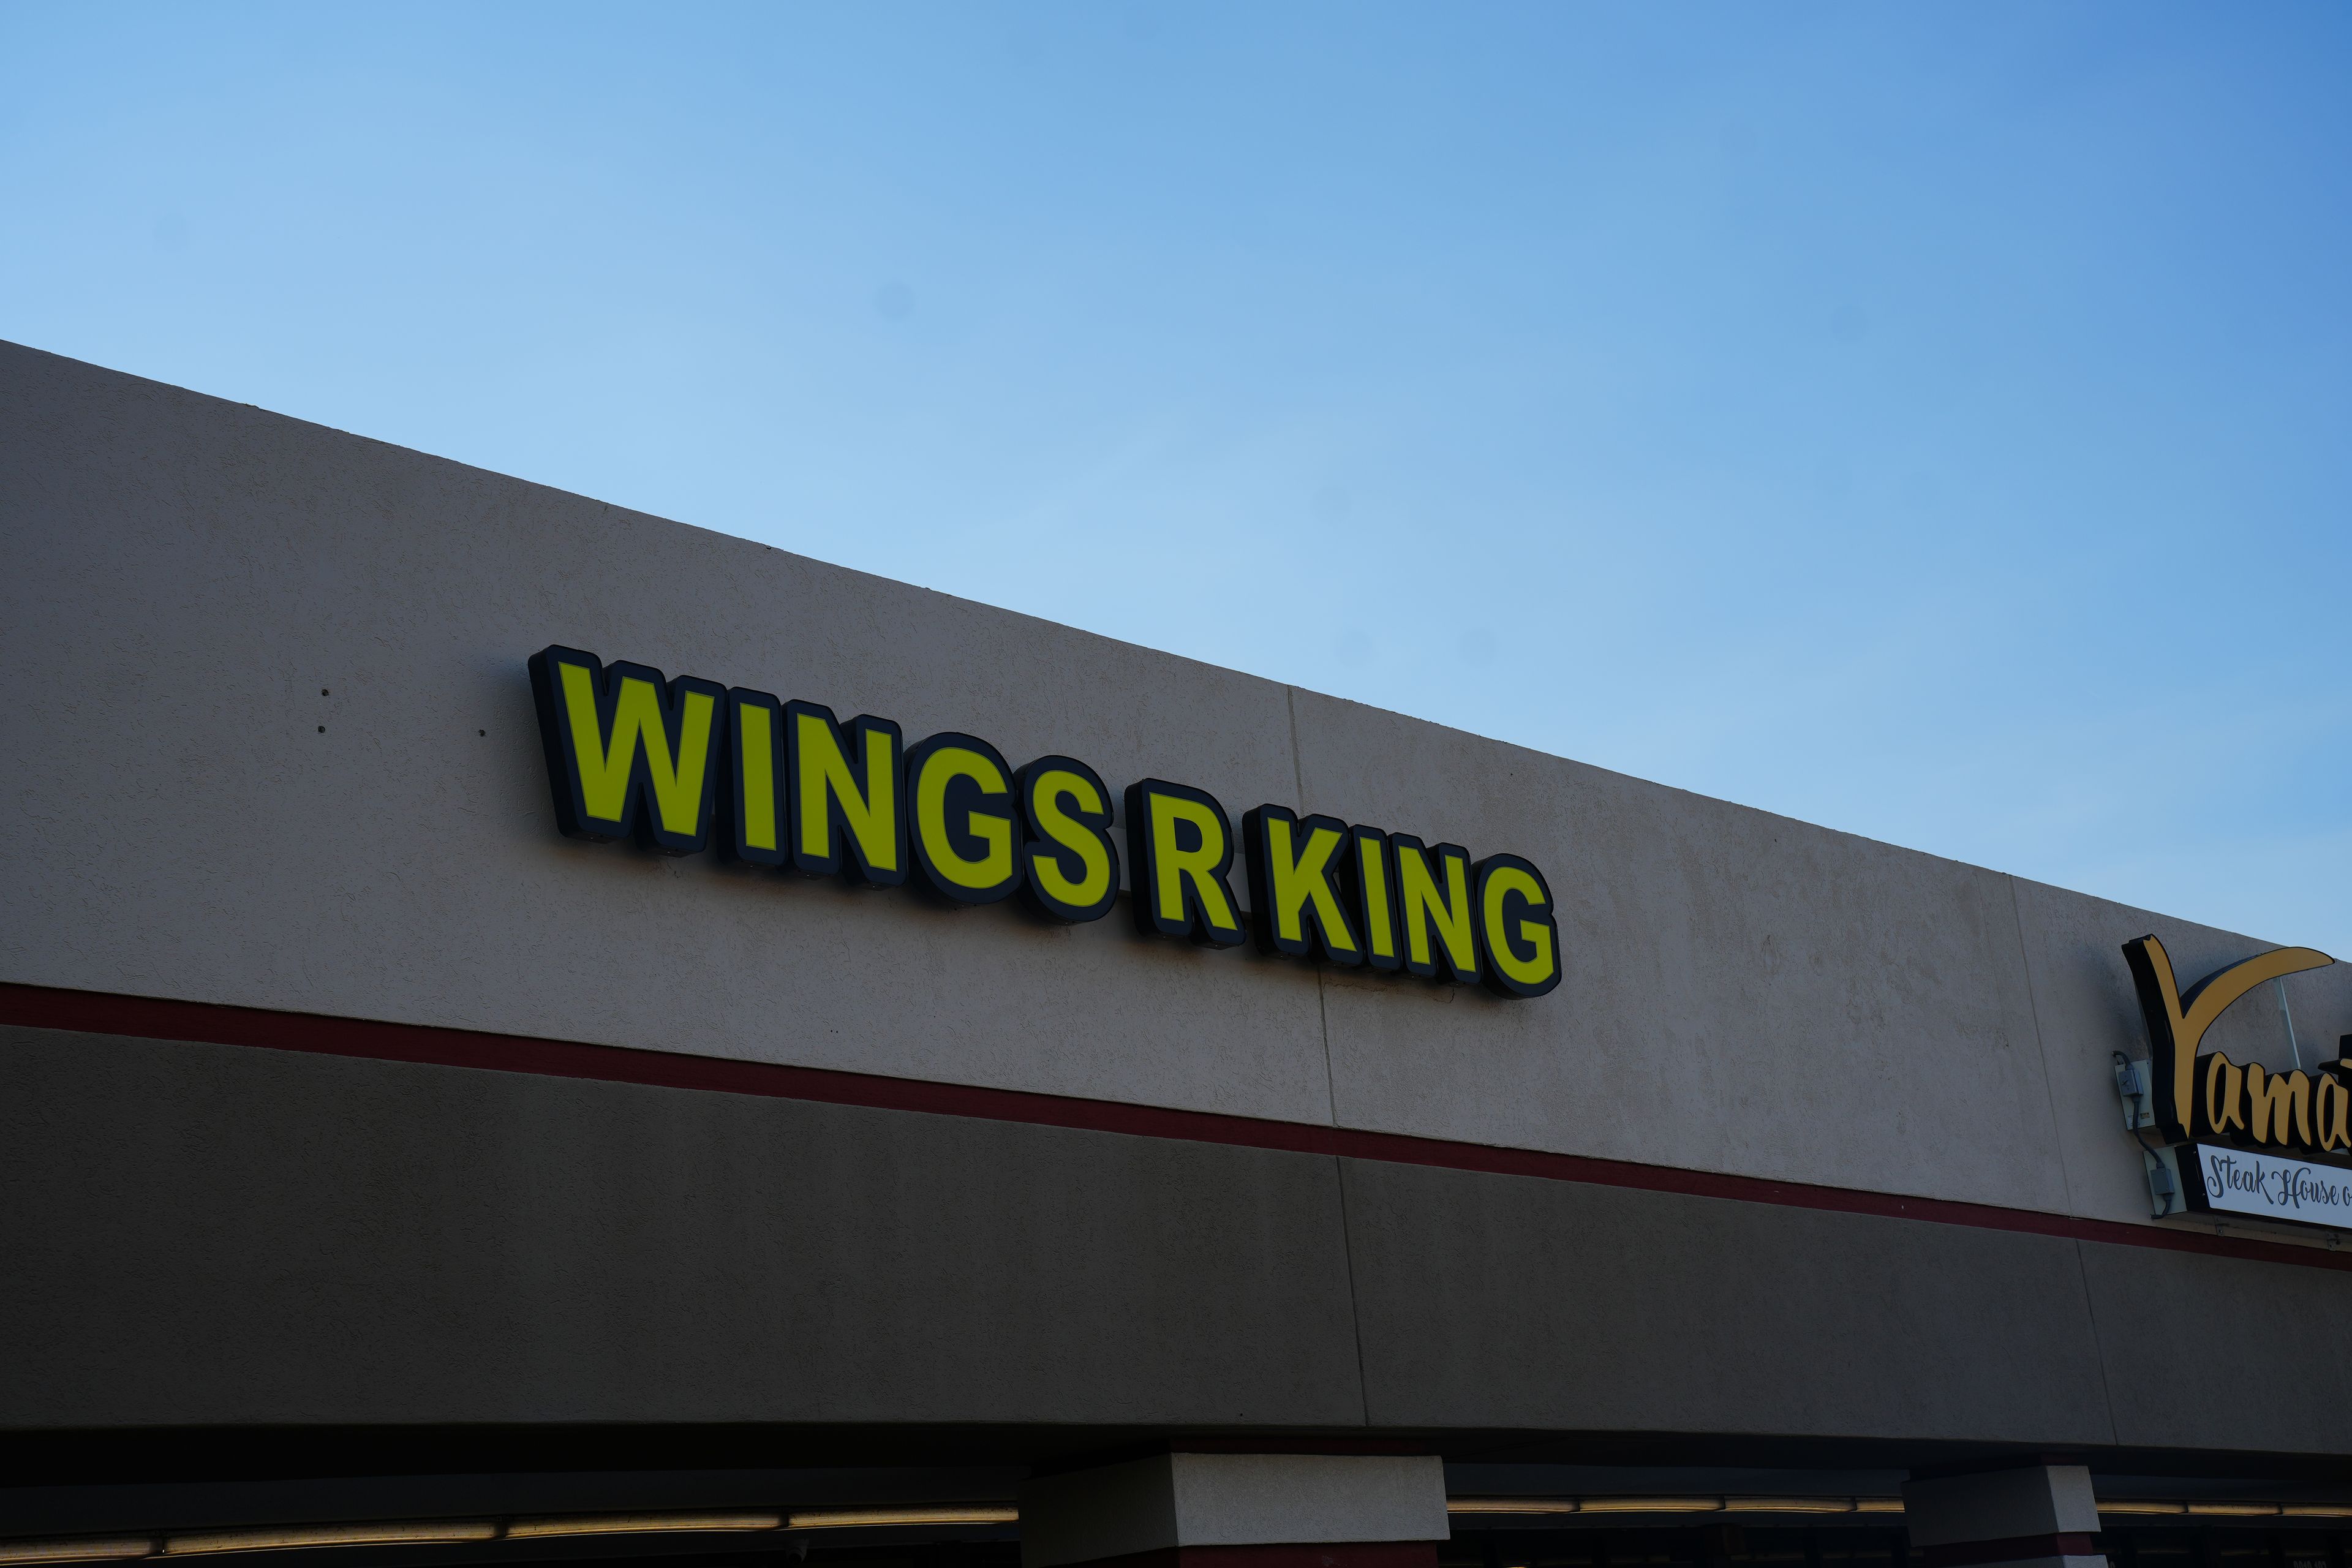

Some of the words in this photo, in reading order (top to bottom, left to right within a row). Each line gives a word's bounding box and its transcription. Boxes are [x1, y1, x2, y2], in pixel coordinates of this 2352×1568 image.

[556, 659, 1112, 909] WINGS
[1147, 789, 1240, 933] R
[1265, 815, 1557, 987] KING
[2143, 935, 2352, 1152] Yama
[2206, 1155, 2274, 1205] Steak
[2271, 1167, 2340, 1210] House
